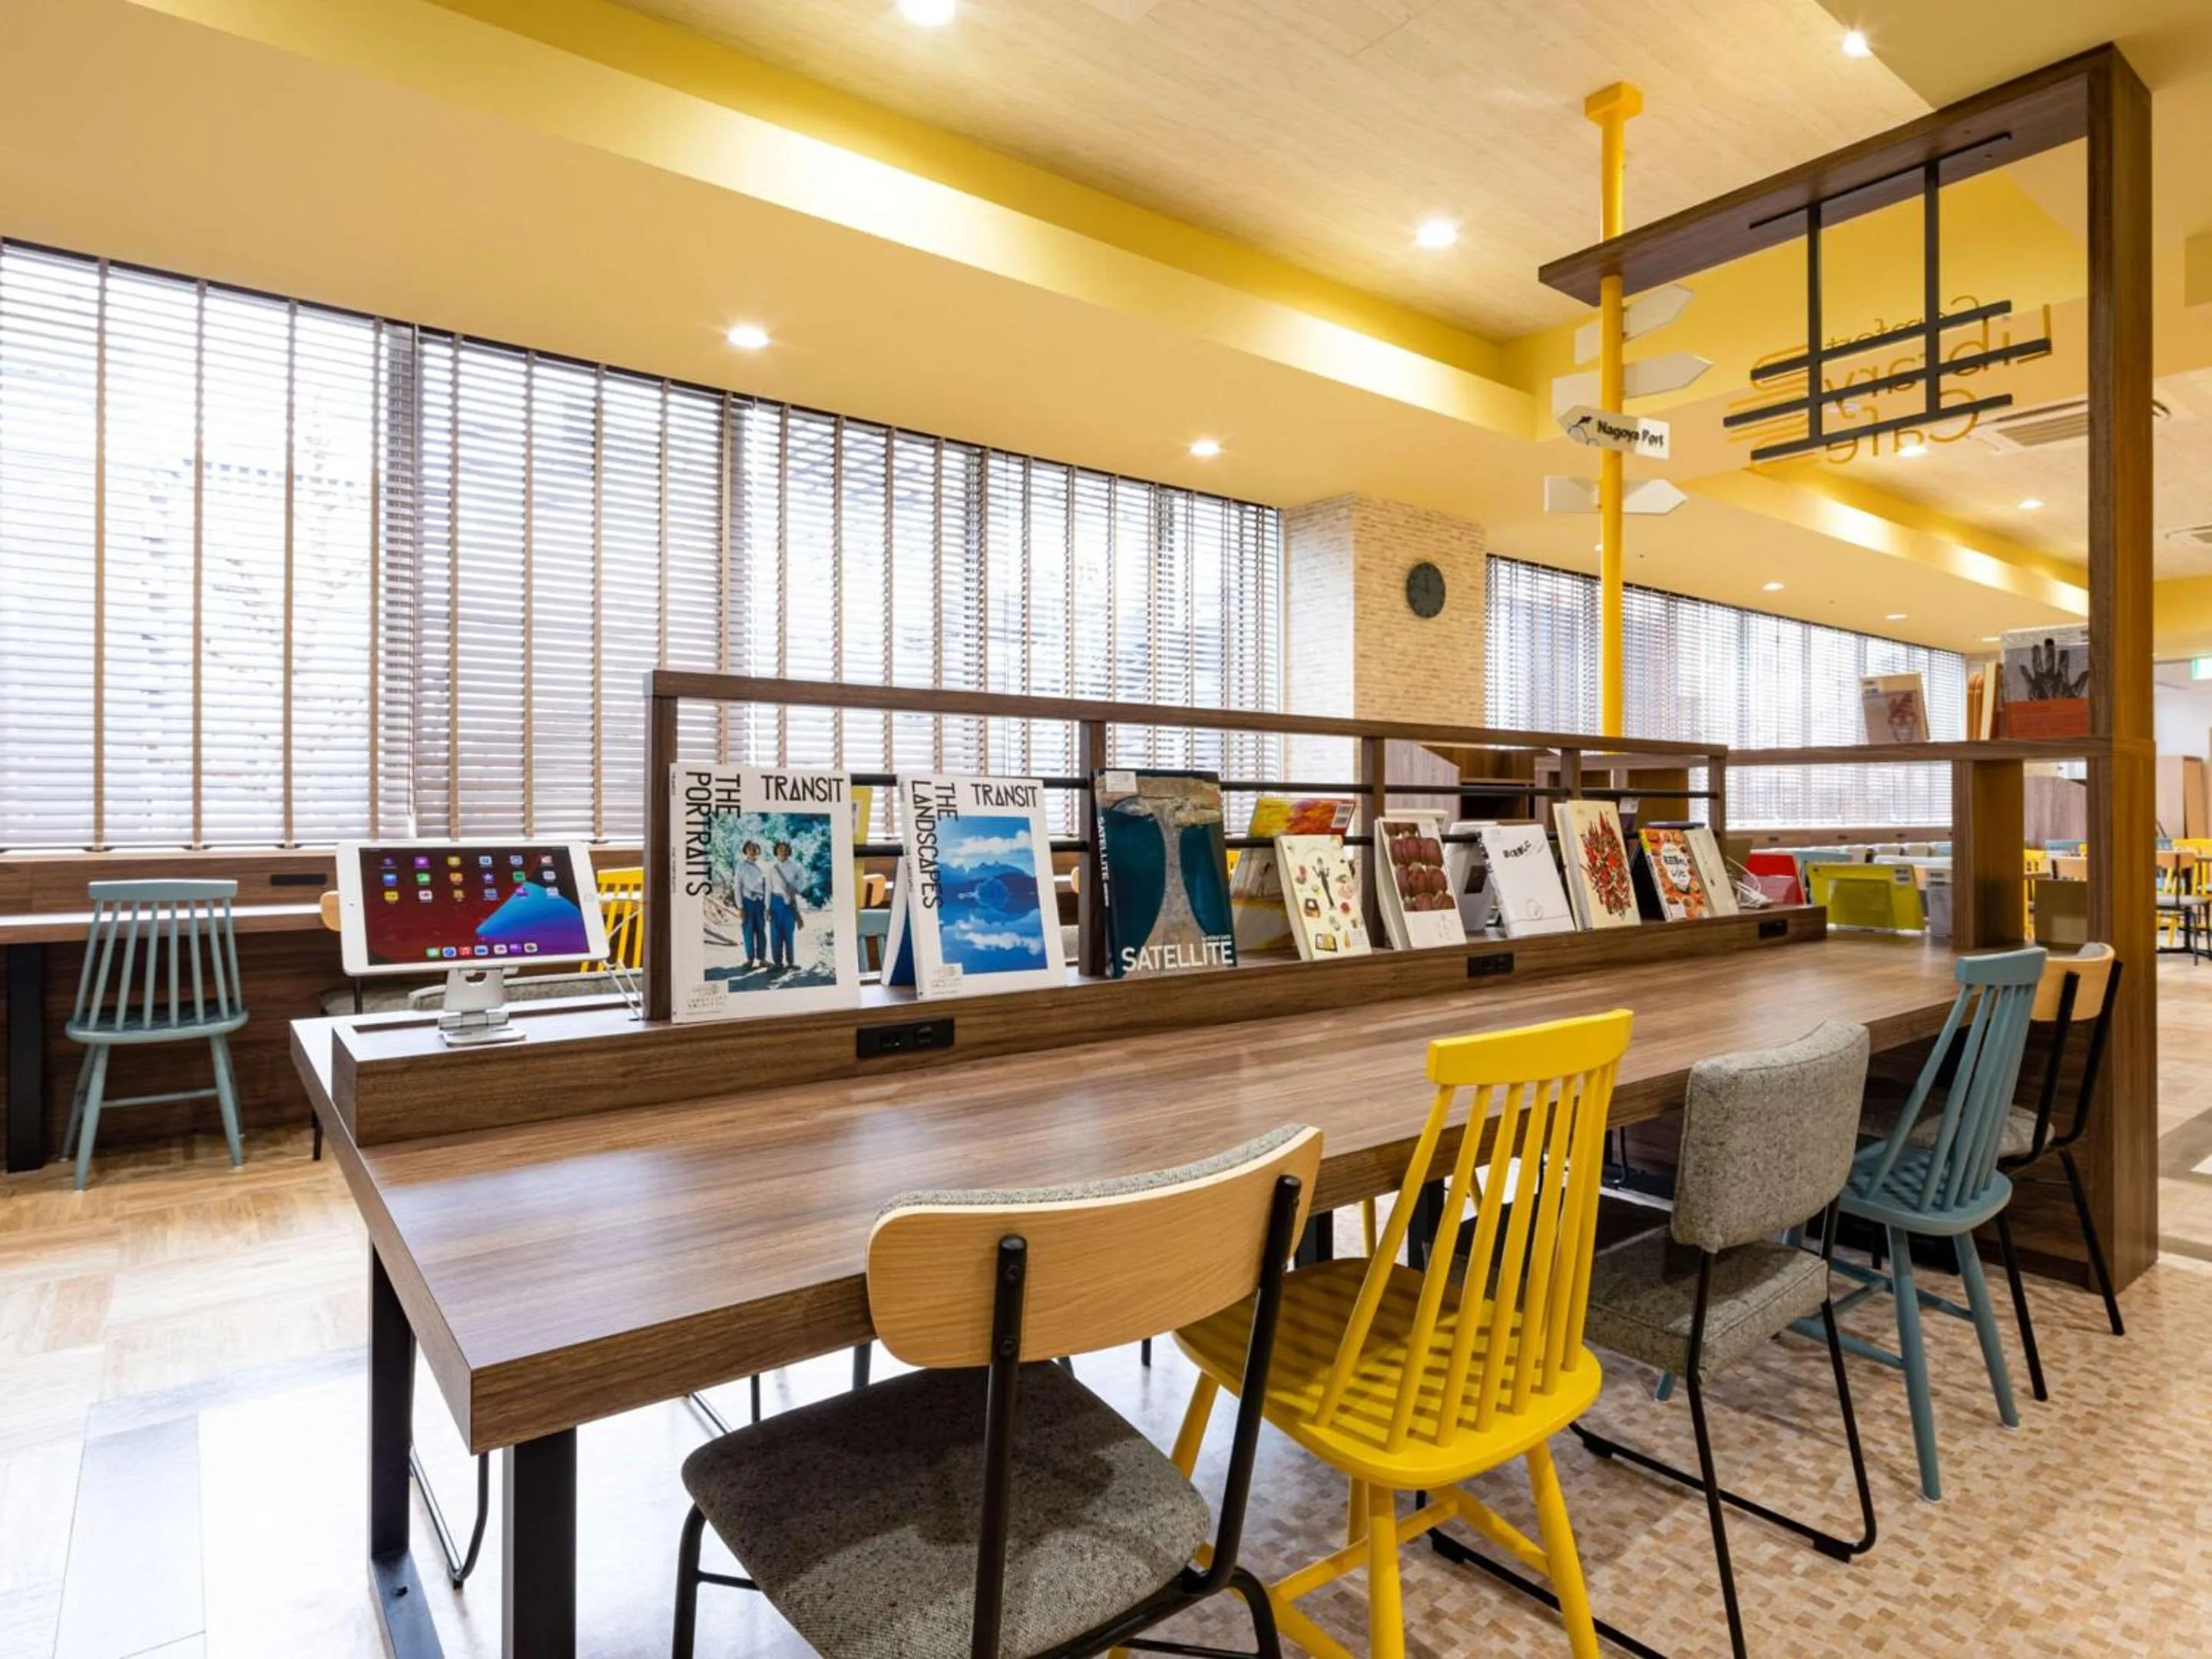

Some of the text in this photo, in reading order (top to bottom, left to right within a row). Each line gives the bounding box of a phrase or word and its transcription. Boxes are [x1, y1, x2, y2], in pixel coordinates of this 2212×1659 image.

[1597, 420, 1664, 449] Nagoya Port
[715, 773, 740, 819] THE
[761, 775, 844, 803] TRANSIT
[935, 782, 959, 822] THE
[970, 783, 1038, 808] TRANSIT
[685, 771, 713, 896] PORTRAITS
[912, 780, 944, 909] LANDSCAPES
[1121, 941, 1233, 972] SATELLITE
